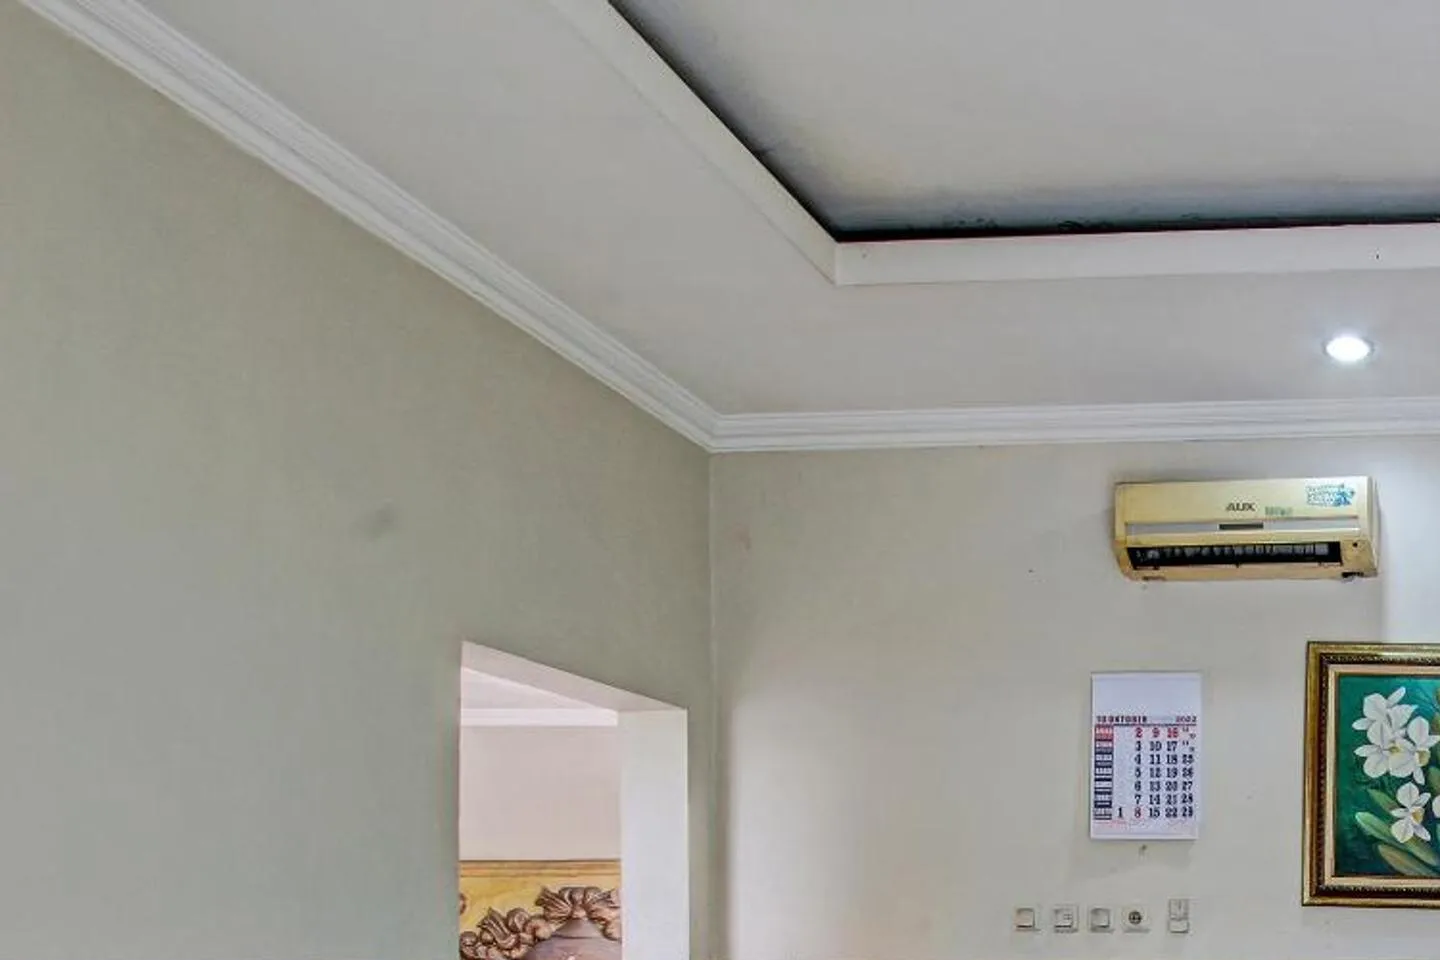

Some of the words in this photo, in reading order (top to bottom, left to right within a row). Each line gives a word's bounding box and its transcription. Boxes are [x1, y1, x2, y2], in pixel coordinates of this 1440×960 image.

[1226, 502, 1256, 512] AUX
[1149, 741, 1162, 752] 10
[1166, 741, 1178, 752] 17
[1149, 754, 1161, 765] 11
[1166, 754, 1178, 765] 18
[1166, 767, 1178, 778] 19
[1149, 781, 1161, 792] 13
[1182, 781, 1193, 792] 27
[1149, 794, 1161, 805] 14
[1165, 794, 1177, 805] 21
[1149, 807, 1161, 818] 15
[1165, 807, 1178, 818] 22
